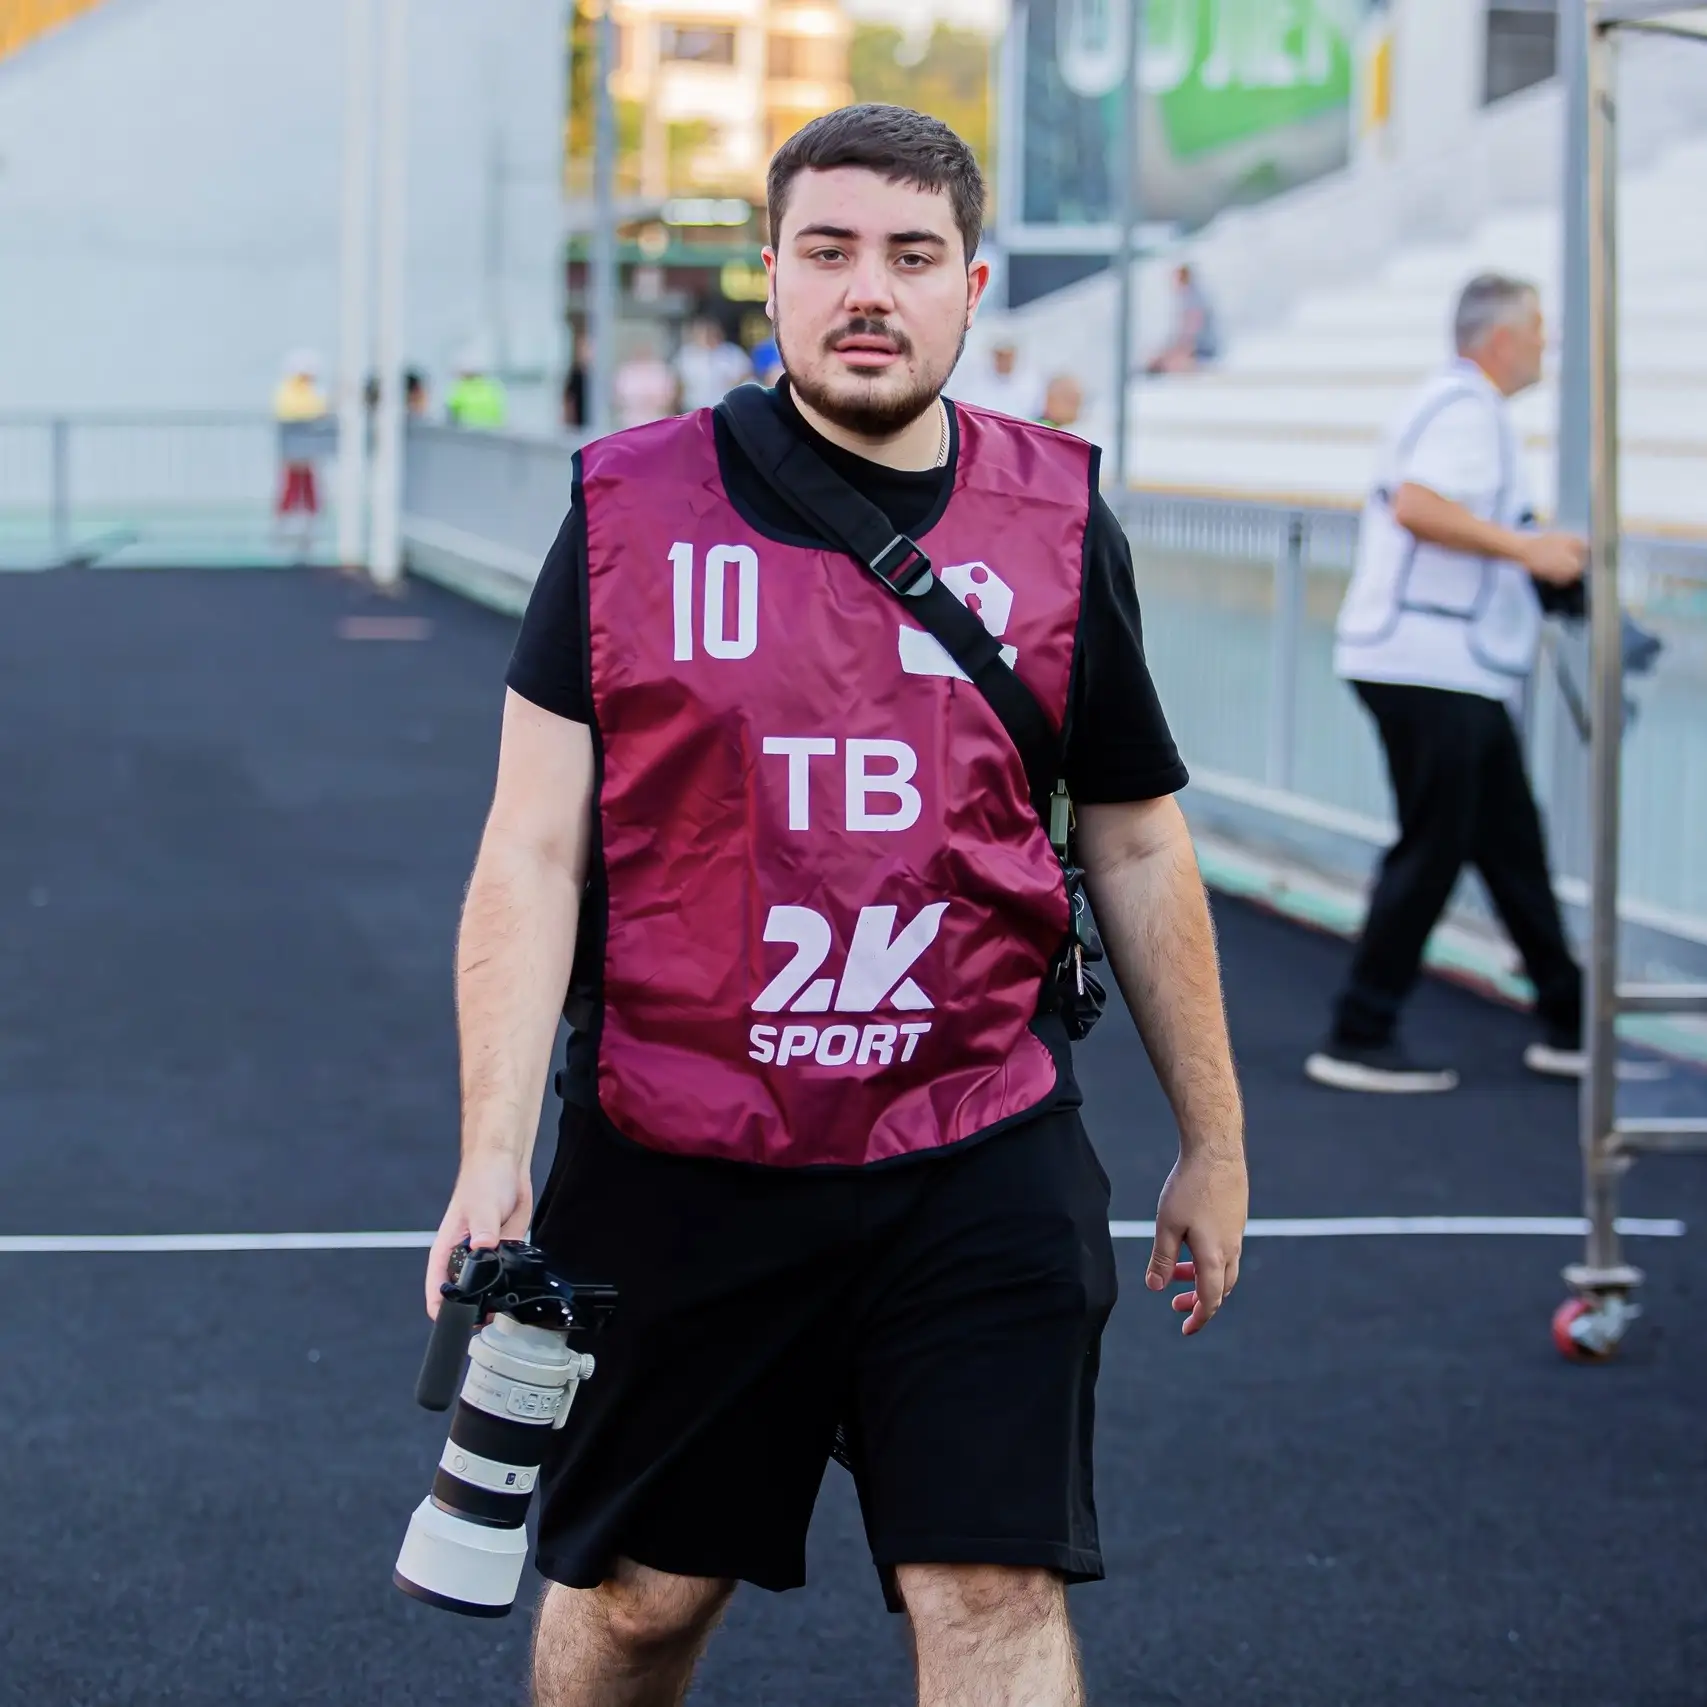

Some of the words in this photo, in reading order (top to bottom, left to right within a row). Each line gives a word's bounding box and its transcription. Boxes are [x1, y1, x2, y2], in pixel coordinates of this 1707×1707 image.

[667, 541, 759, 662] 10
[751, 902, 951, 1012] 2K
[748, 1022, 932, 1066] SPORT
